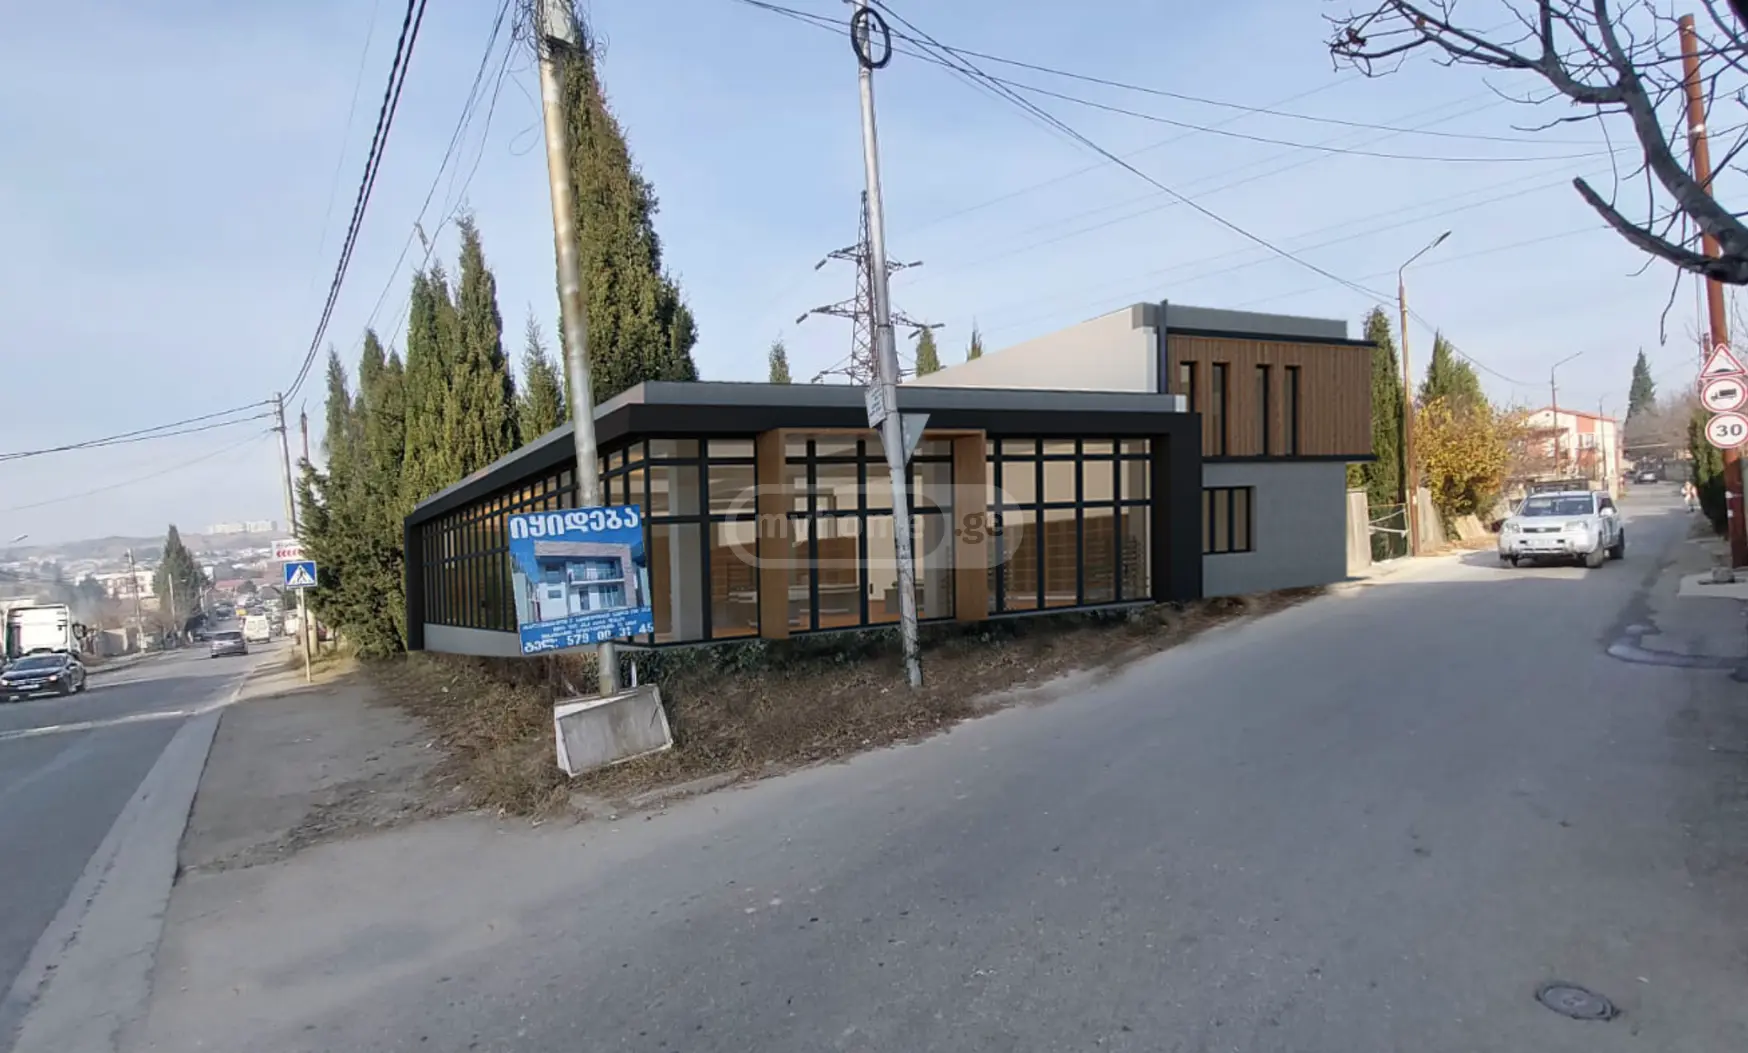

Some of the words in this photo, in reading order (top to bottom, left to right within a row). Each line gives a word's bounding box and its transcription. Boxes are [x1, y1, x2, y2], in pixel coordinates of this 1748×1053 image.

[1716, 424, 1742, 437] 30
[510, 507, 638, 539] იყიდება
[567, 633, 590, 646] 579
[597, 630, 612, 641] 00
[618, 626, 632, 637] 31
[638, 623, 654, 633] 45
